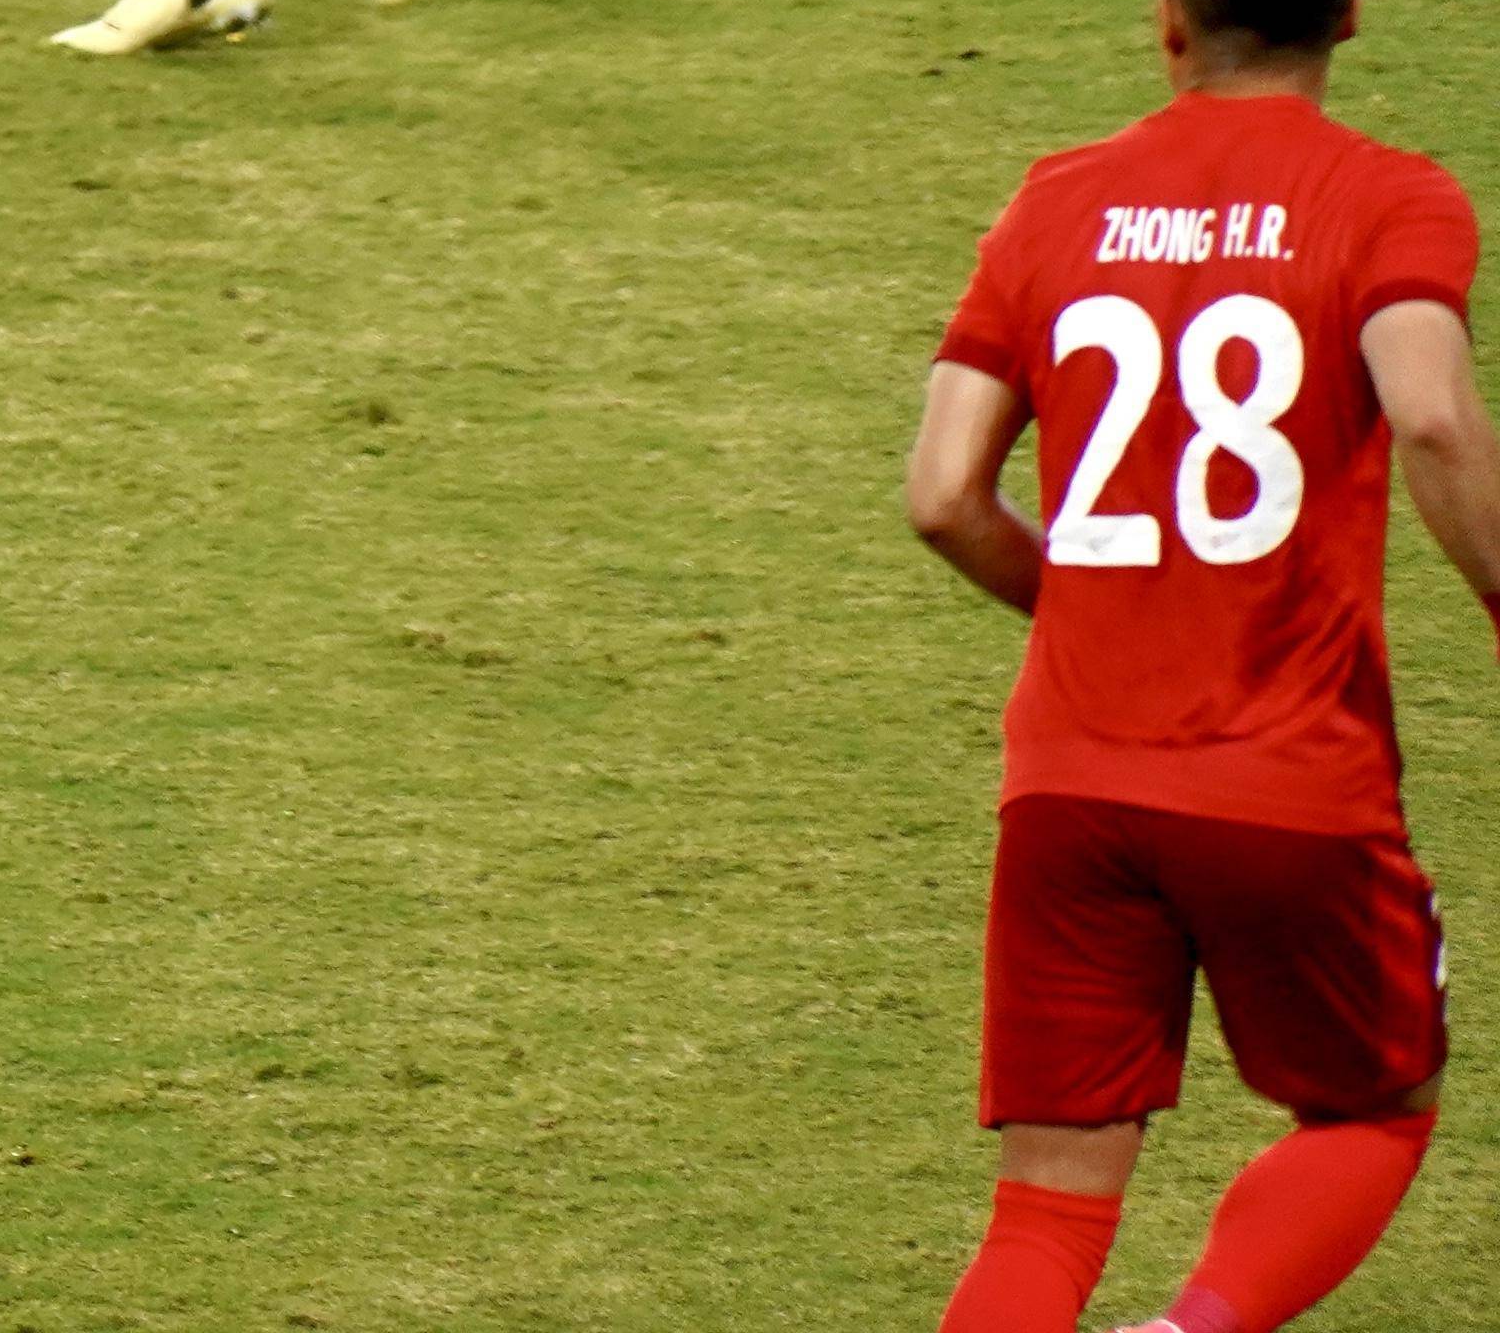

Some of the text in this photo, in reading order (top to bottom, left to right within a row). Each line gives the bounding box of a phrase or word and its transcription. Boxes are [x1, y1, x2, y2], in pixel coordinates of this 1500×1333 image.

[1095, 201, 1295, 264] ZHONG H.R.
[1047, 293, 1304, 567] 28
